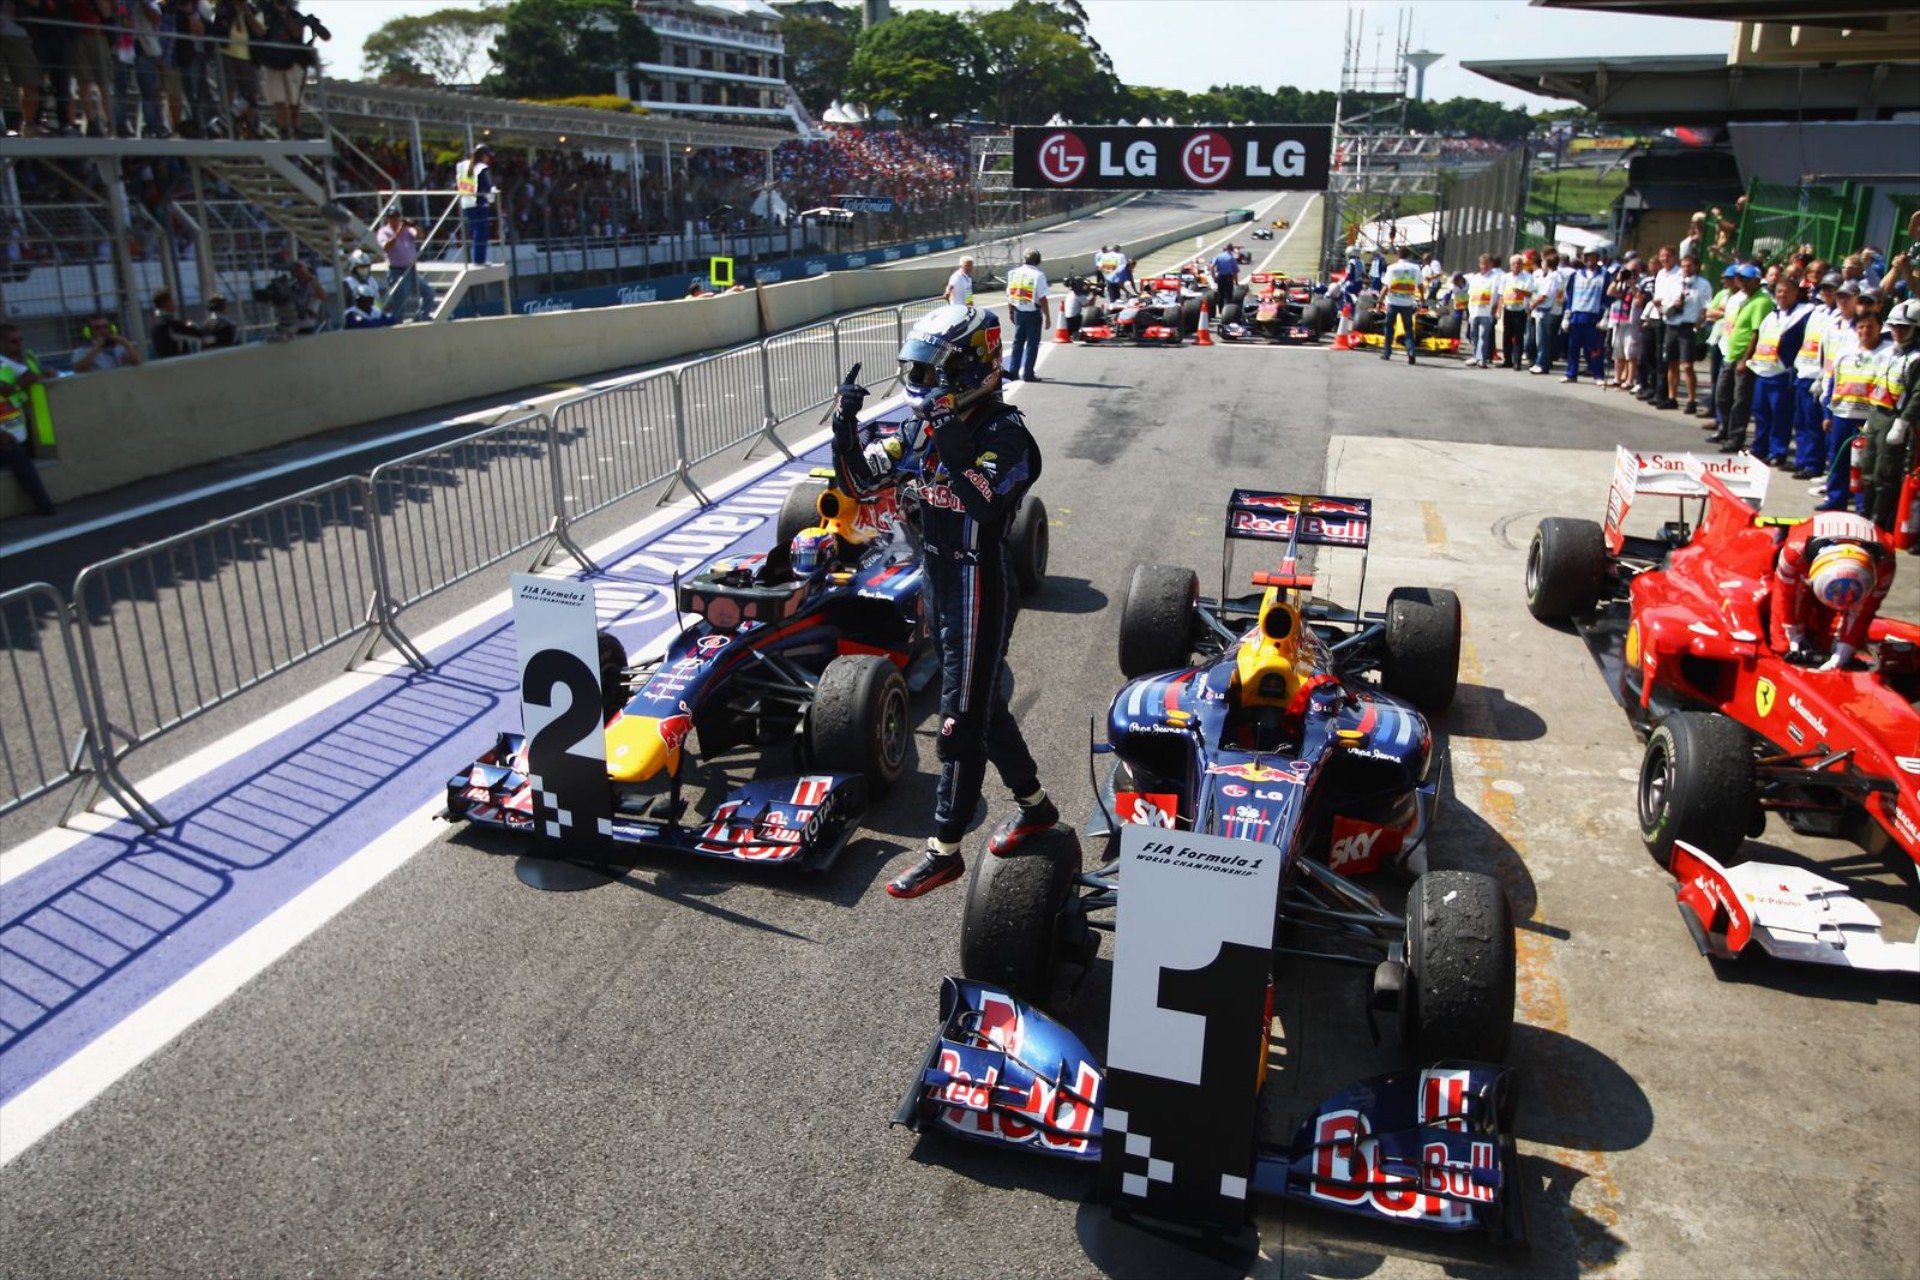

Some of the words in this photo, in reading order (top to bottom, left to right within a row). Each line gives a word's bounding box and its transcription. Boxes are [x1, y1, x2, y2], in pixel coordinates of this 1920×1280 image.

[1100, 140, 1157, 177] LG
[1246, 140, 1306, 177] LG
[1652, 455, 1749, 474] Sannder
[1231, 510, 1297, 536] Red
[1301, 515, 1368, 540] Bull
[523, 585, 540, 594] FIA
[541, 588, 579, 600] Formula
[522, 649, 605, 774] 2
[1255, 789, 1283, 801] LG
[1136, 854, 1171, 864] WORLD
[1142, 842, 1174, 855] FIA
[1177, 847, 1249, 867] Formula
[1250, 858, 1263, 869] 1
[1329, 828, 1383, 870] SKY
[1156, 941, 1272, 1087] 1
[1423, 1142, 1494, 1202] Bull
